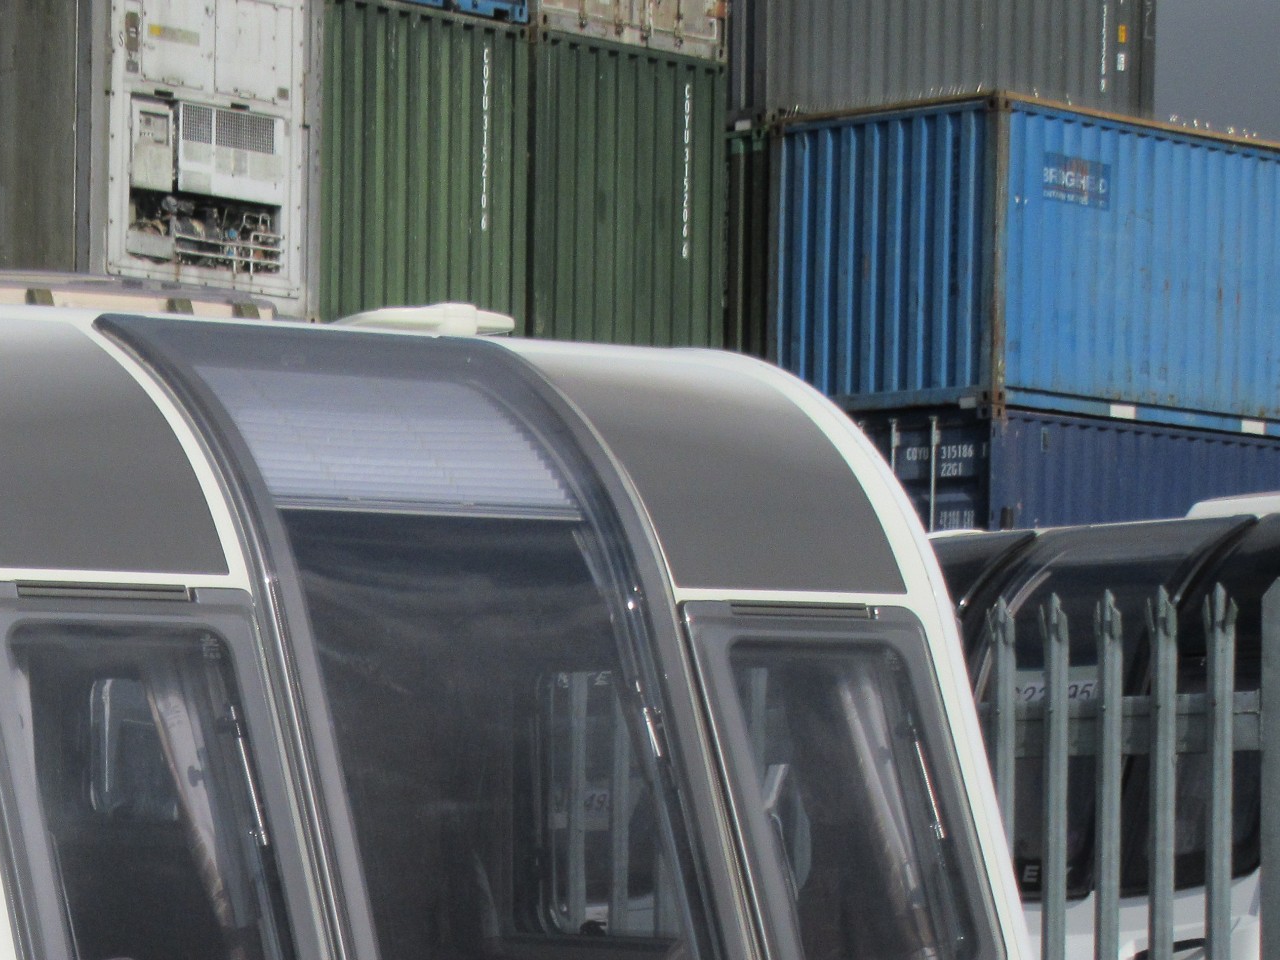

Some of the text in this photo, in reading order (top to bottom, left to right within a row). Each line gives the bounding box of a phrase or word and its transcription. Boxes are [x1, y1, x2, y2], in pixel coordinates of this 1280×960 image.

[482, 47, 490, 111] COYU
[683, 83, 691, 144] COYU
[481, 114, 489, 209] 315210
[681, 147, 690, 238] 315206
[940, 444, 974, 459] 315186
